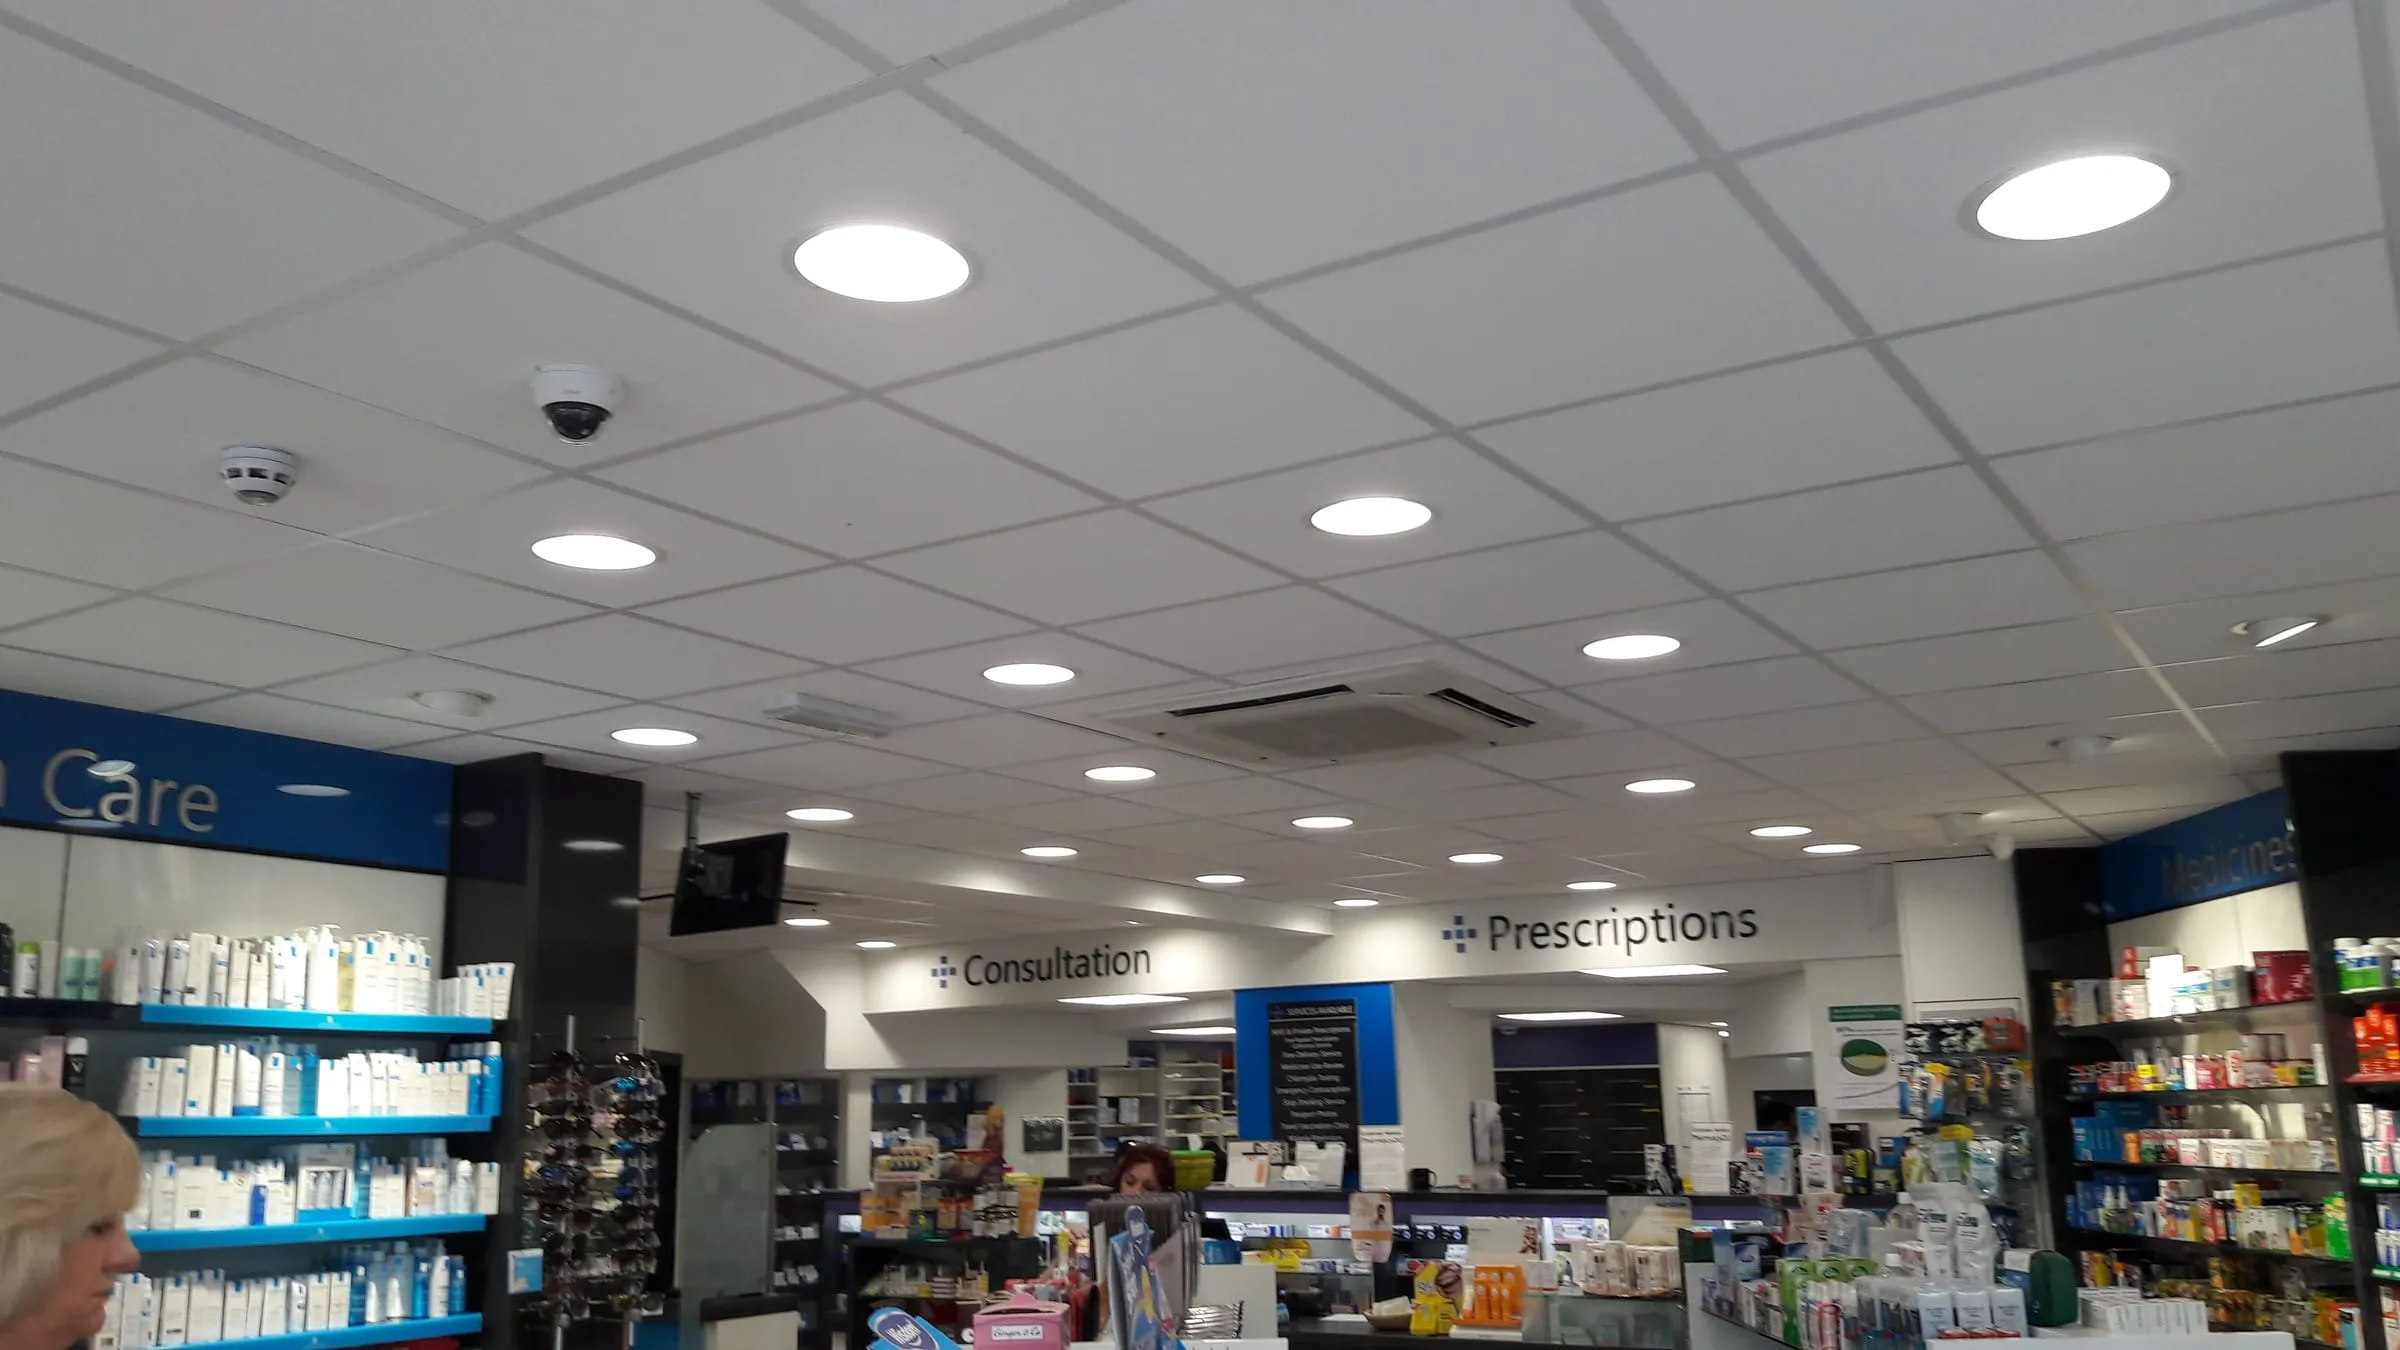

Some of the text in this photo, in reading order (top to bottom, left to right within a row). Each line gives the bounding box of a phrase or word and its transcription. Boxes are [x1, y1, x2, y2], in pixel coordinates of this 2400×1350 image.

[43, 748, 219, 833] Care
[1488, 903, 1759, 957] Prescriptions
[963, 943, 1151, 987] Consultation
